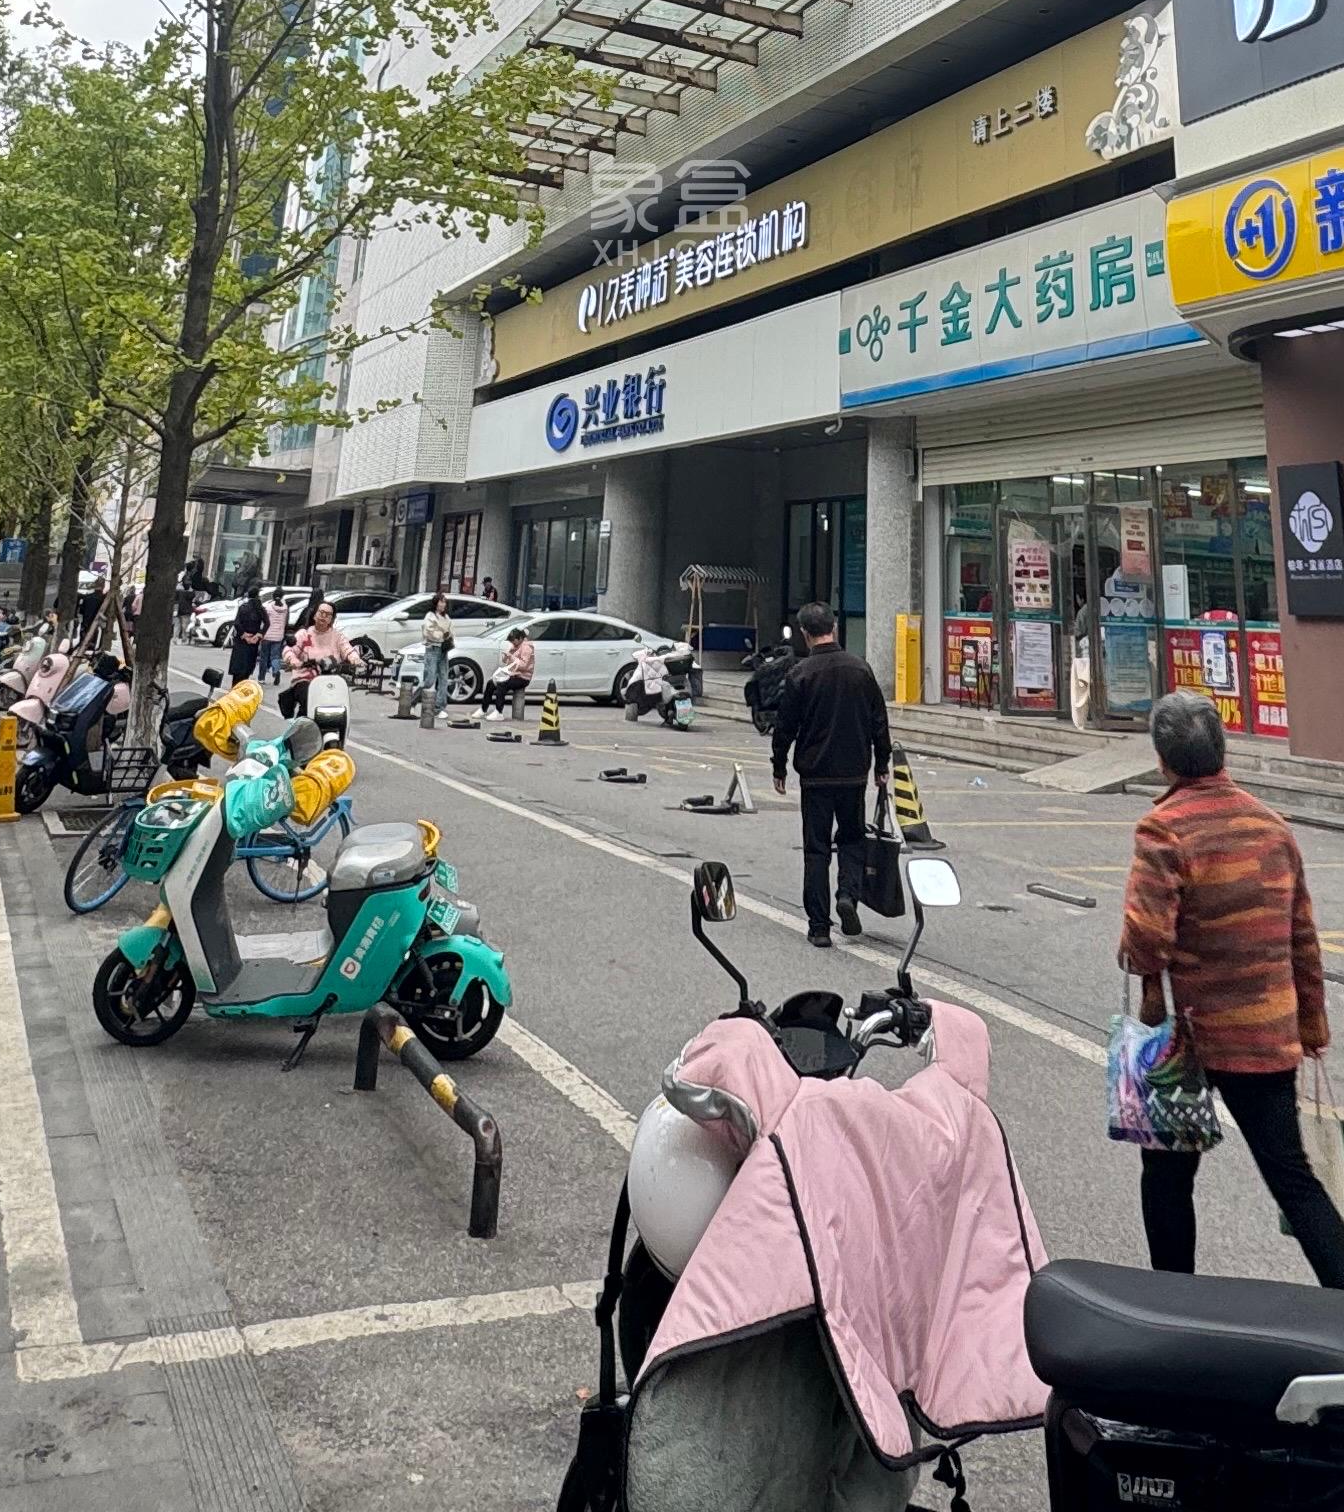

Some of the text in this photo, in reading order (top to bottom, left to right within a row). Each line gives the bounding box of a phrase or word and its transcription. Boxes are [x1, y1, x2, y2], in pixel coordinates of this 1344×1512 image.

[971, 85, 1058, 145] 请上二楼
[897, 235, 1136, 354] 千金大药房
[581, 364, 666, 429] 兴业银行
